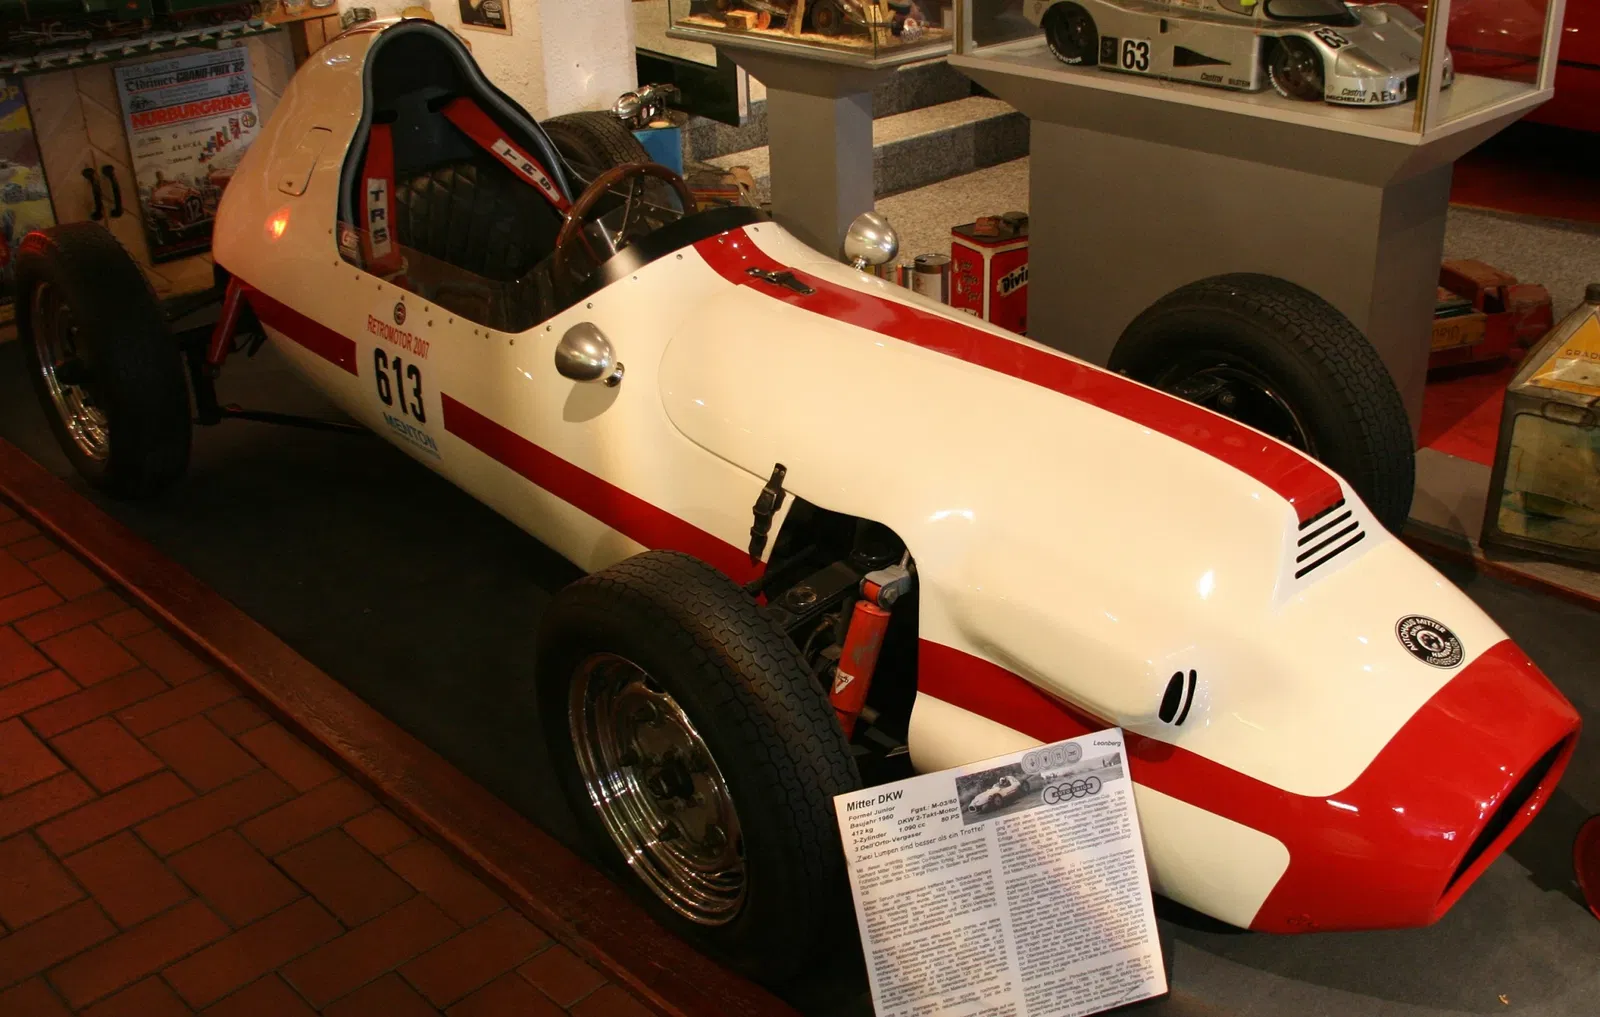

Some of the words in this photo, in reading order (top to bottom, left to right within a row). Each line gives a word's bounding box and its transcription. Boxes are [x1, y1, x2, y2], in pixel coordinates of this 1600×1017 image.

[1314, 28, 1349, 48] 63
[1122, 40, 1149, 71] 63
[1326, 95, 1365, 103] MICHELIN
[370, 189, 387, 243] TRS
[367, 314, 412, 352] RETROMOTOR
[413, 336, 430, 360] 2007
[1566, 349, 1600, 361] GRAD
[374, 348, 426, 423] 613
[1416, 618, 1446, 633] MITTER
[846, 797, 875, 810] Mitter
[877, 790, 904, 803] DKW
[910, 804, 930, 814] Fgst.:
[848, 811, 872, 821] Formel
[873, 805, 895, 815] Junior
[849, 817, 877, 829] Baujahr
[878, 813, 894, 821] 1960
[897, 816, 915, 825] DKW
[915, 805, 958, 820] 2-Takt-Motor
[864, 826, 874, 834] kg
[898, 823, 916, 832] 1.090
[852, 831, 887, 844] 3-Zylinder
[860, 830, 922, 851] Dell'Orto-Vergaser
[874, 846, 898, 858] Lumpen
[899, 842, 913, 851] sind
[914, 837, 936, 847] besser
[937, 834, 946, 842] als
